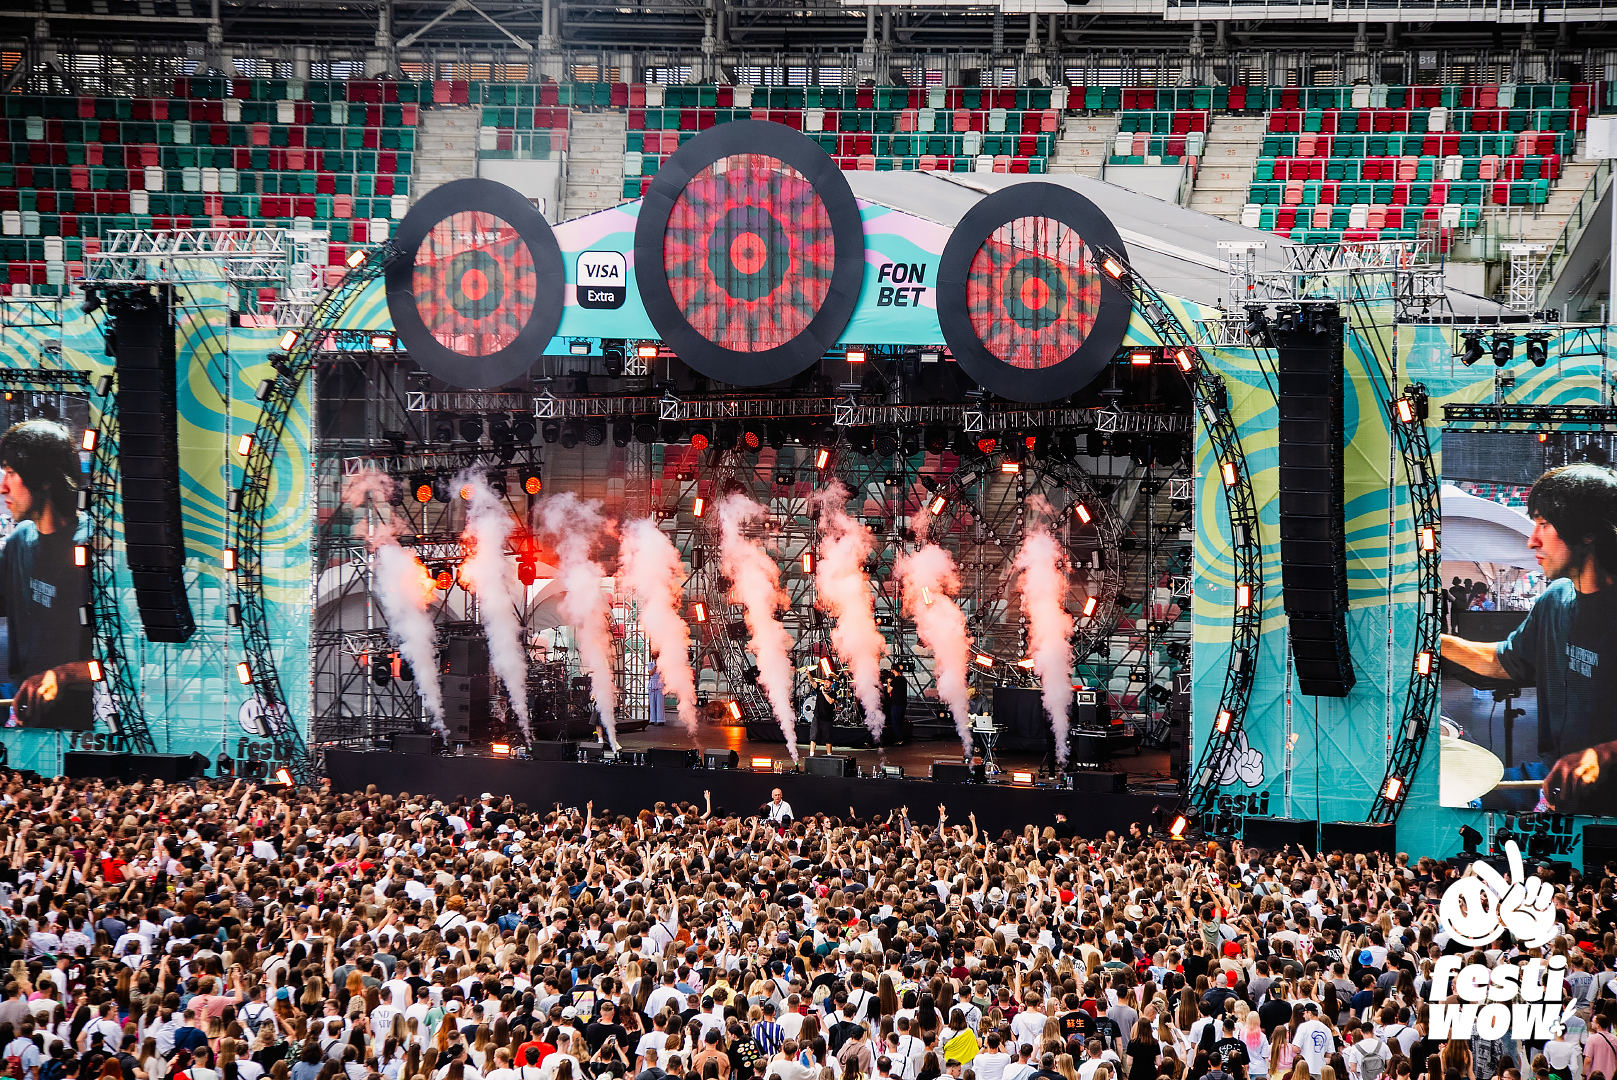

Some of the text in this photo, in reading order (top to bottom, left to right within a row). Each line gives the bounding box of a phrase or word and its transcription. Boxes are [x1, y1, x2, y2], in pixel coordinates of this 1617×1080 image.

[857, 58, 874, 67] B15
[1419, 56, 1437, 65] B14
[584, 264, 619, 278] VISA
[877, 263, 926, 283] FON
[587, 289, 615, 302] Extra
[877, 287, 926, 307] BET
